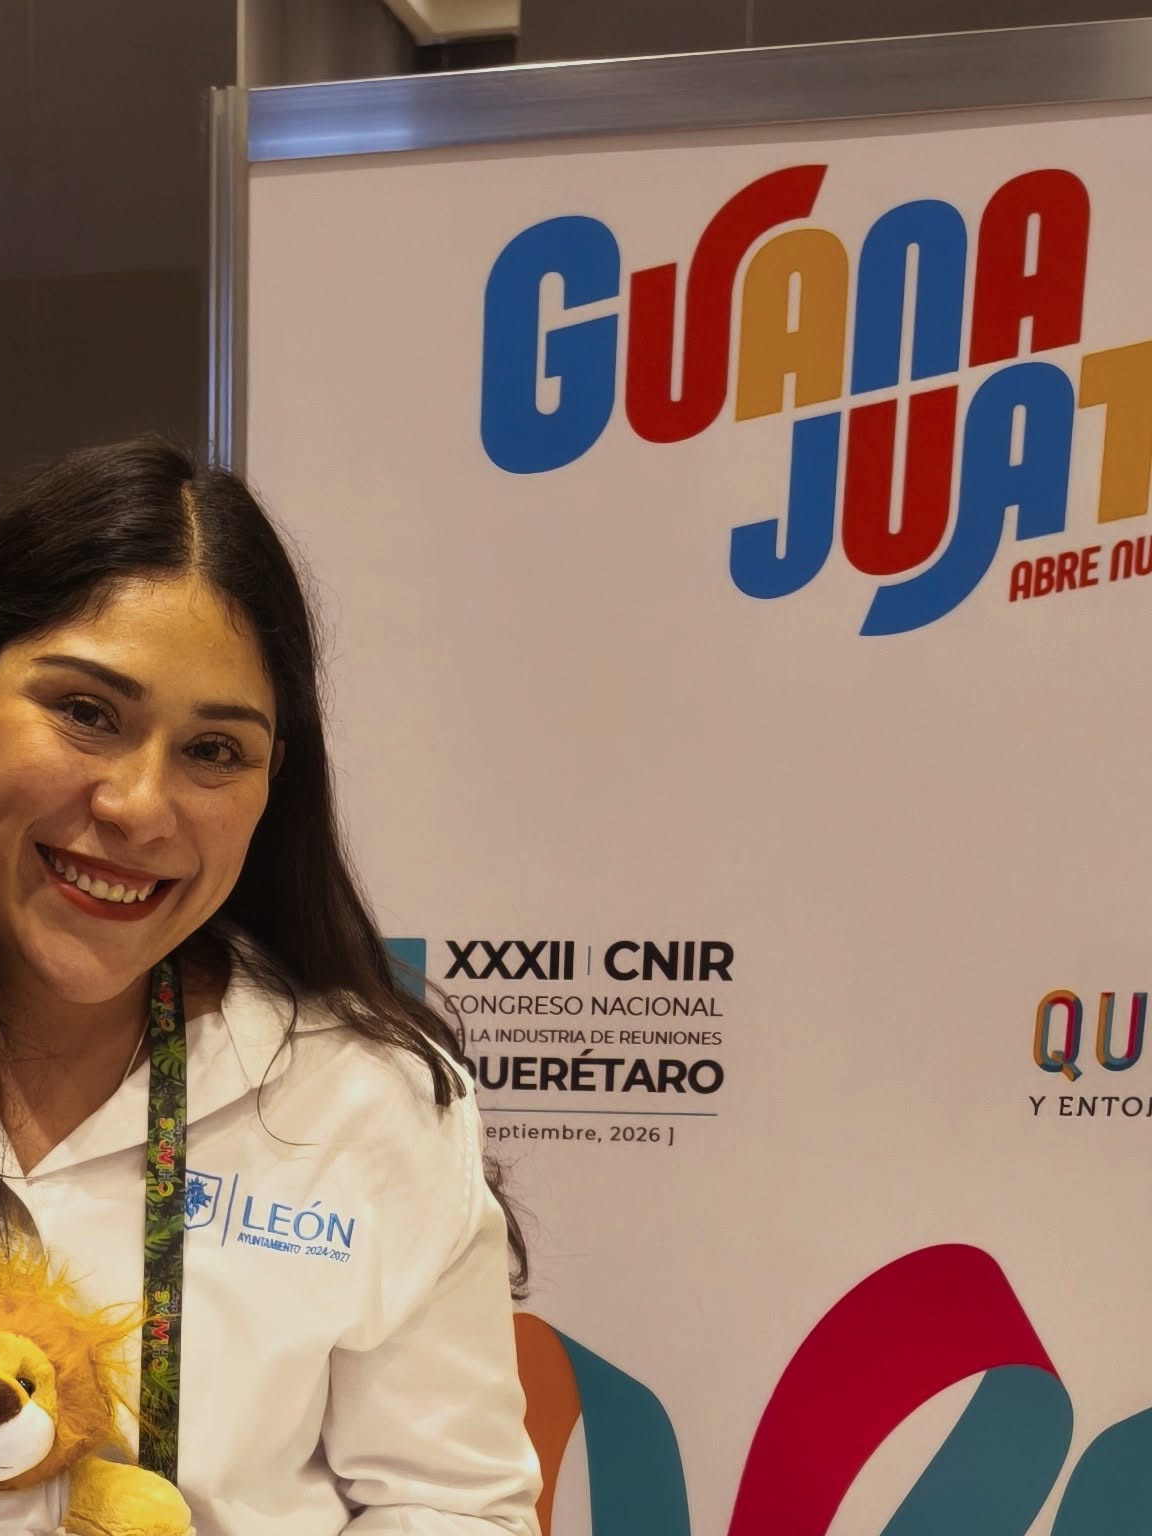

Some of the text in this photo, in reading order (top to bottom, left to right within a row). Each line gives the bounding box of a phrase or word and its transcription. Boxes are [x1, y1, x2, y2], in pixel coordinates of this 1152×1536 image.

[480, 164, 1091, 475] GUANA
[1008, 545, 1101, 602] ABRE
[444, 940, 734, 981] XXXII CNIR
[444, 995, 724, 1017] CONGRESO NACIONAL
[470, 1029, 490, 1042] LA
[495, 1029, 586, 1044] INDUSTRIA
[591, 1030, 615, 1044] DE
[620, 1031, 723, 1045] REUNIONES
[1033, 989, 1149, 1082] QU
[1029, 1096, 1152, 1117] Y ENTO
[485, 1124, 602, 1143] eptiembre,
[610, 1126, 661, 1142] 2026
[242, 1195, 355, 1249] LEÓN
